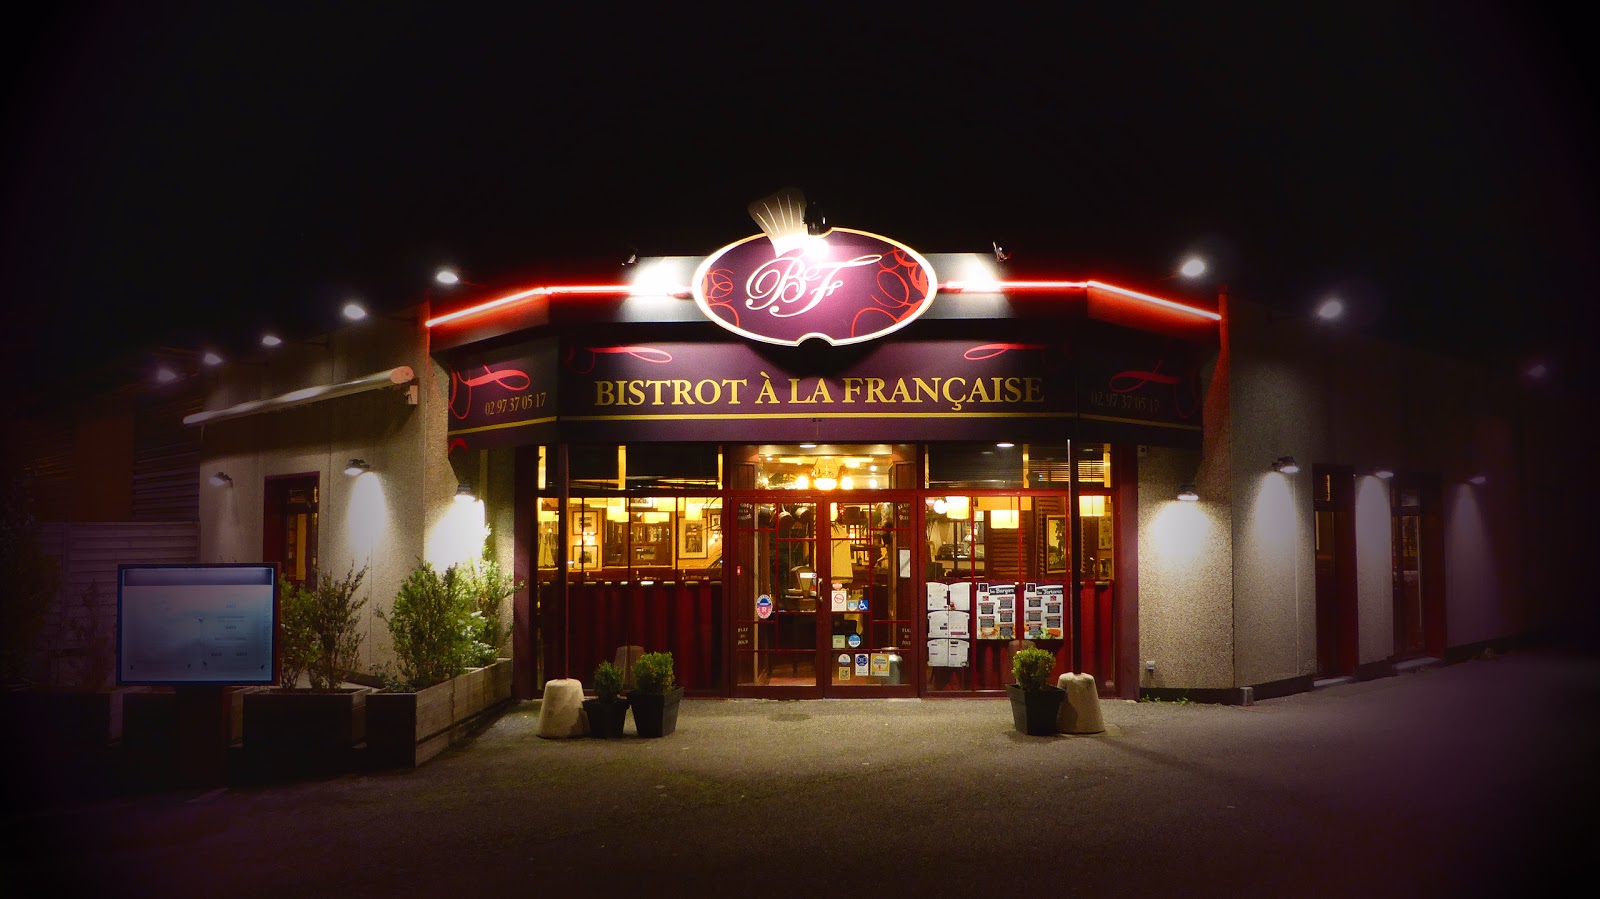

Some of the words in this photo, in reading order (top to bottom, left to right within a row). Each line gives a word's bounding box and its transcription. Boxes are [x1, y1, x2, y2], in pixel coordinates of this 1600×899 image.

[594, 378, 748, 406] BISTROT
[755, 371, 781, 404] À
[788, 378, 834, 404] LA
[841, 377, 1045, 411] FRANÇAISE
[1120, 395, 1133, 409] 37
[485, 401, 495, 416] 02
[496, 399, 507, 414] 97
[509, 396, 520, 412] 37
[521, 394, 533, 410] 05
[536, 392, 547, 408] 17
